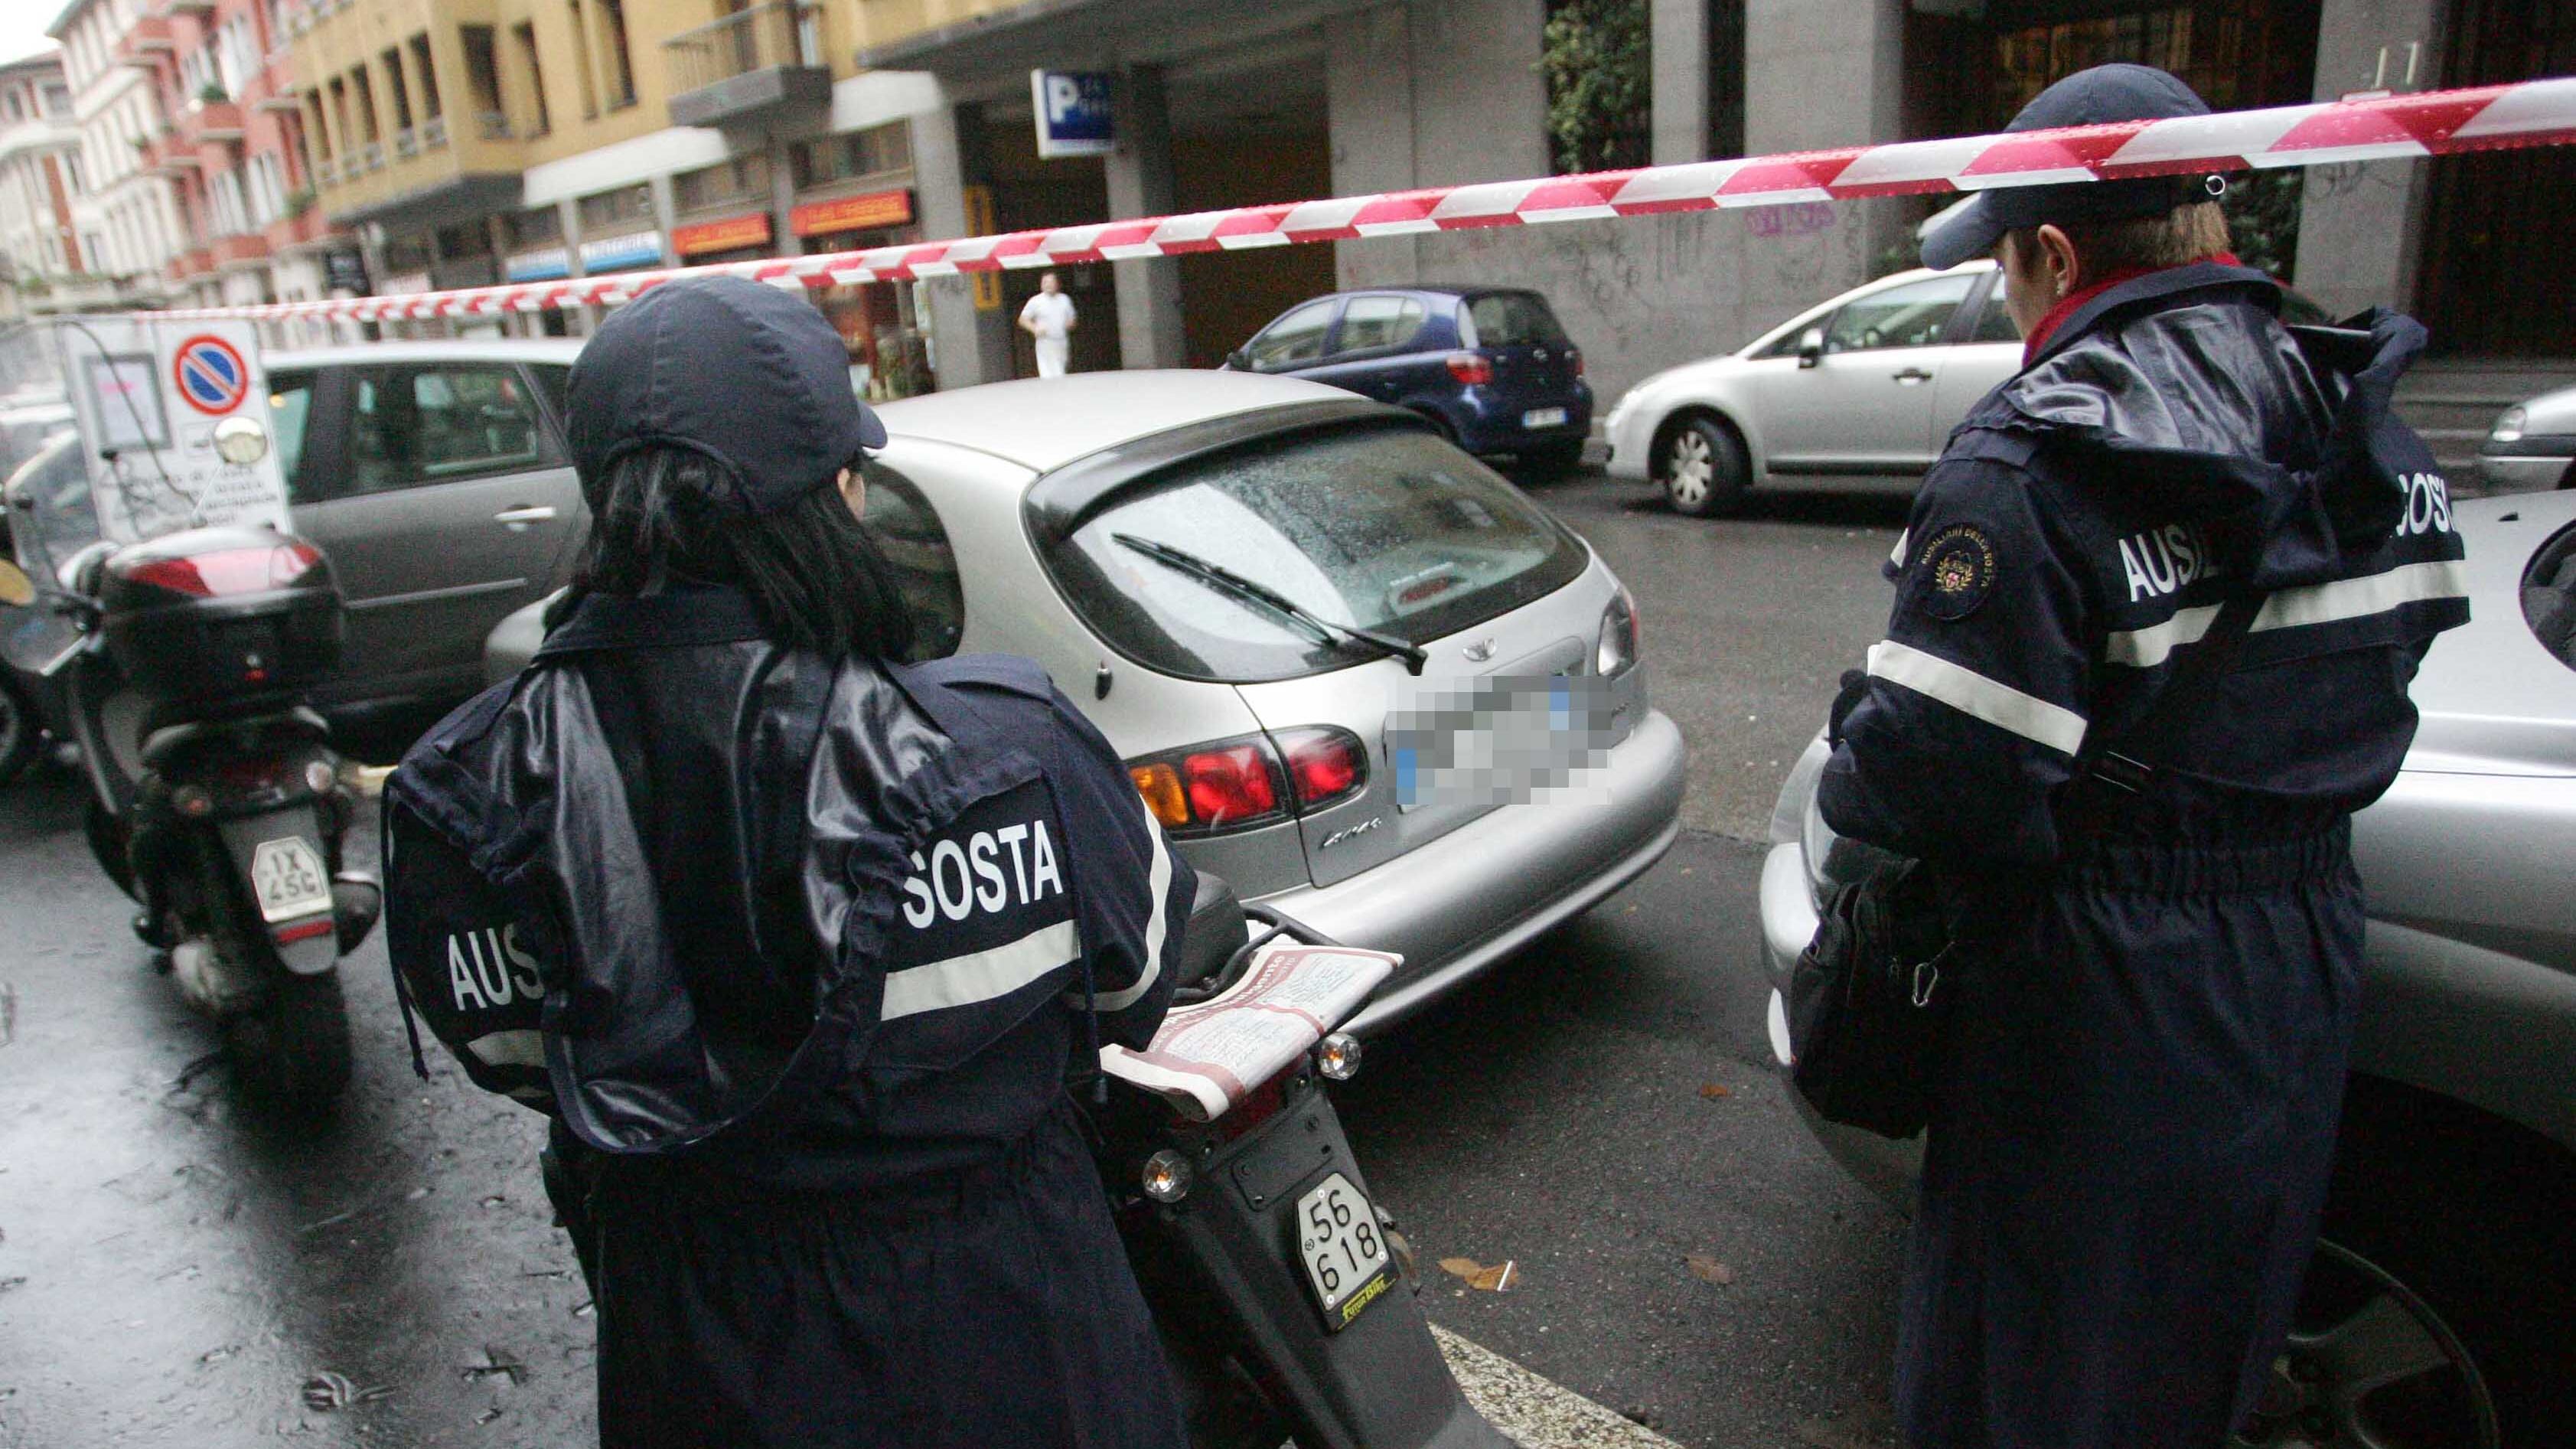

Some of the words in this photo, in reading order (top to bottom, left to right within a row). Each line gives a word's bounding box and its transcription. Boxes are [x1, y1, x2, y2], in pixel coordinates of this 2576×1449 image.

[1047, 75, 1078, 122] P
[902, 819, 1064, 929] SOSTA
[1309, 1190, 1352, 1243] 56
[1317, 1221, 1378, 1291] 618
